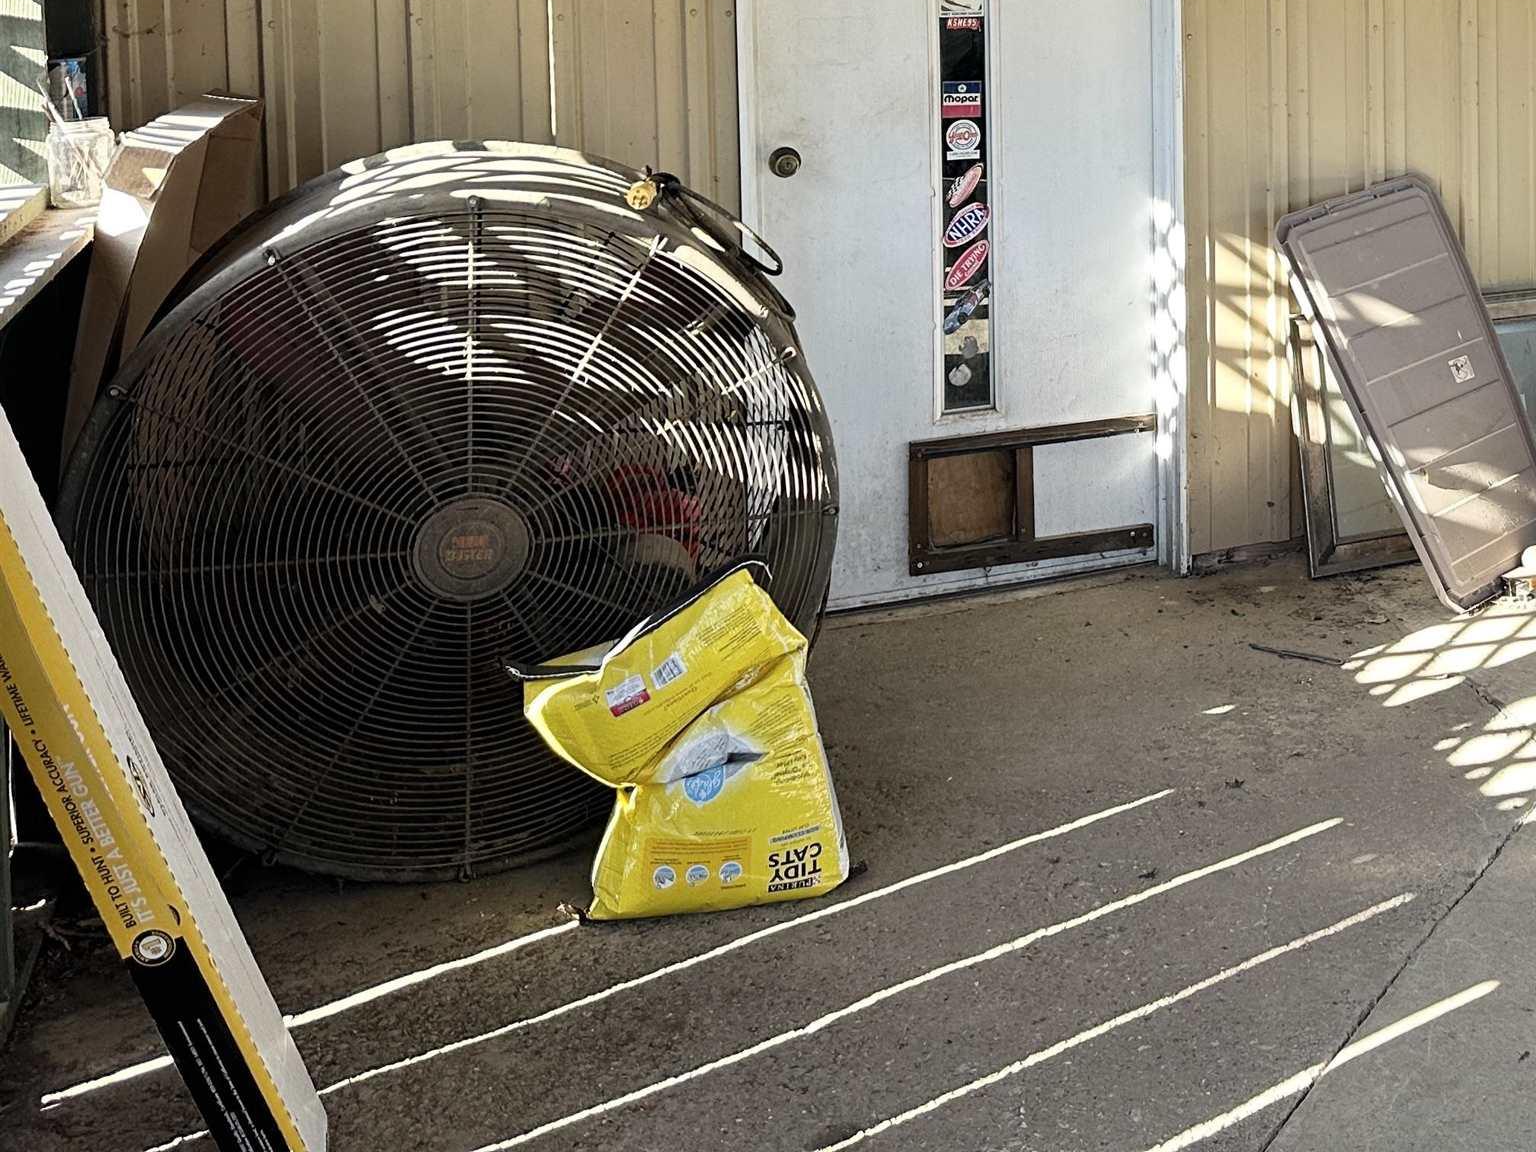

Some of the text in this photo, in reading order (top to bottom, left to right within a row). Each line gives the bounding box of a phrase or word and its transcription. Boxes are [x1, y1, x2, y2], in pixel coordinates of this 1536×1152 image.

[949, 207, 985, 240] NHRA
[949, 271, 963, 286] DIE
[961, 243, 986, 272] TRYING
[11, 682, 35, 726] LIFETIME
[32, 737, 69, 793] ACCURACY
[61, 762, 89, 797] GUN
[63, 795, 94, 845] SUPERIOR
[80, 798, 114, 847] BETTER
[107, 847, 123, 859] A
[769, 842, 822, 868] CATS
[91, 855, 114, 886] HUNT
[112, 864, 141, 894] JUST
[770, 859, 821, 882] TIDY
[770, 878, 812, 891] PURINA
[107, 885, 124, 905] TO
[130, 896, 155, 922] IT'S
[115, 903, 136, 929] BUILT
